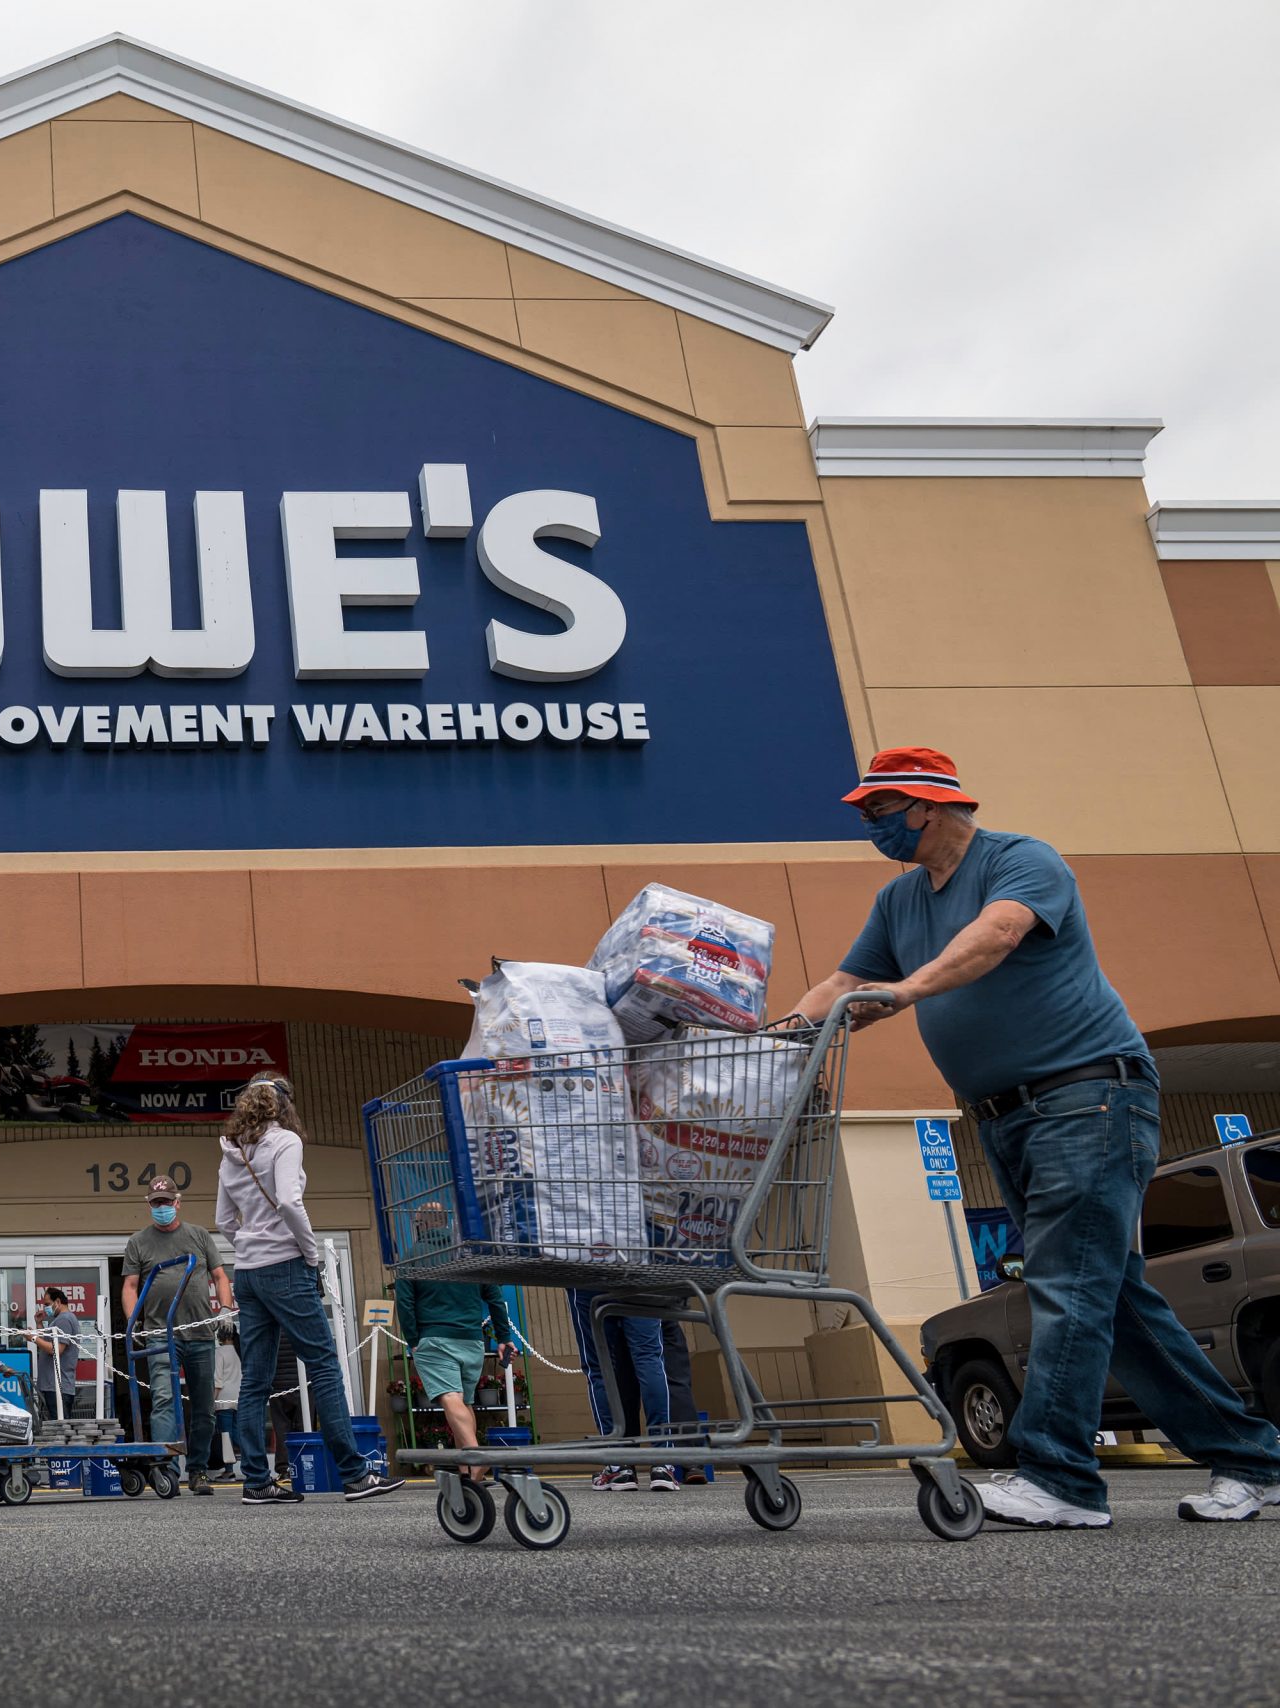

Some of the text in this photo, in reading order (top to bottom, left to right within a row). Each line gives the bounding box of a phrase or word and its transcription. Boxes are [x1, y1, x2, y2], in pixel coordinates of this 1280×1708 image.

[290, 701, 650, 748] WAREHOUSE
[139, 1048, 276, 1066] HONDA
[534, 1060, 552, 1068] USA
[140, 1093, 207, 1108] NOW AT
[922, 1146, 951, 1157] PARKING
[929, 1158, 948, 1169] ONLY
[86, 1161, 192, 1192] 1340
[944, 1188, 959, 1197] $250
[680, 1220, 727, 1238] KINGSF
[969, 1224, 1007, 1264] W
[368, 1475, 380, 1484] N
